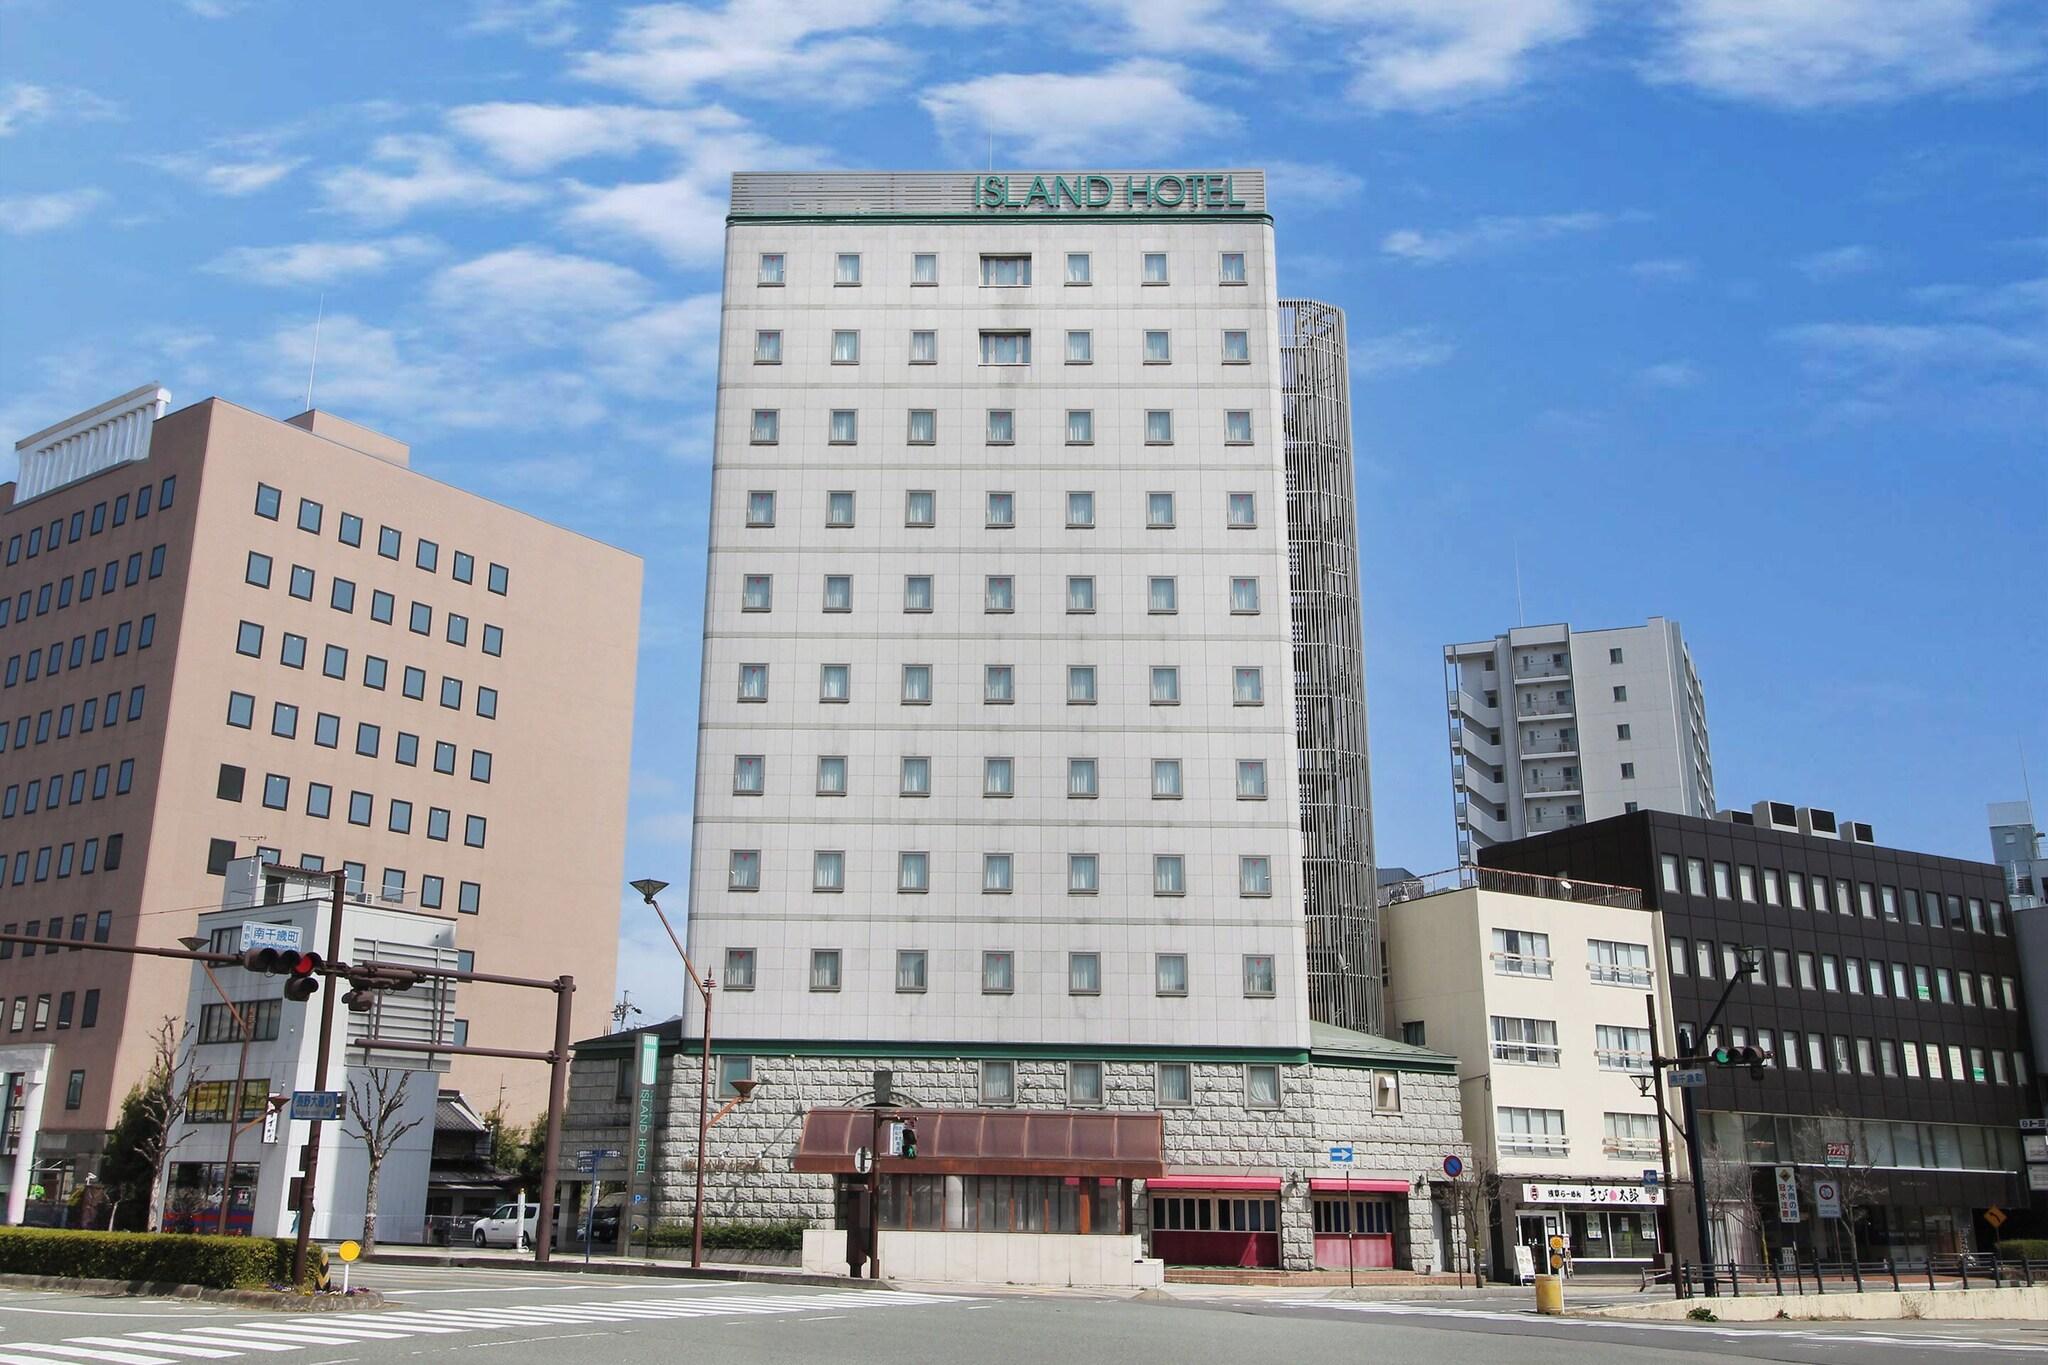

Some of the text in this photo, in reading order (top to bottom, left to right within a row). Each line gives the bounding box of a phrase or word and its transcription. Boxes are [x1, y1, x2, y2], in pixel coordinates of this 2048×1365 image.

[975, 174, 1246, 207] ISLAND HOTEL
[636, 1089, 651, 1176] ISLAND HOTEL
